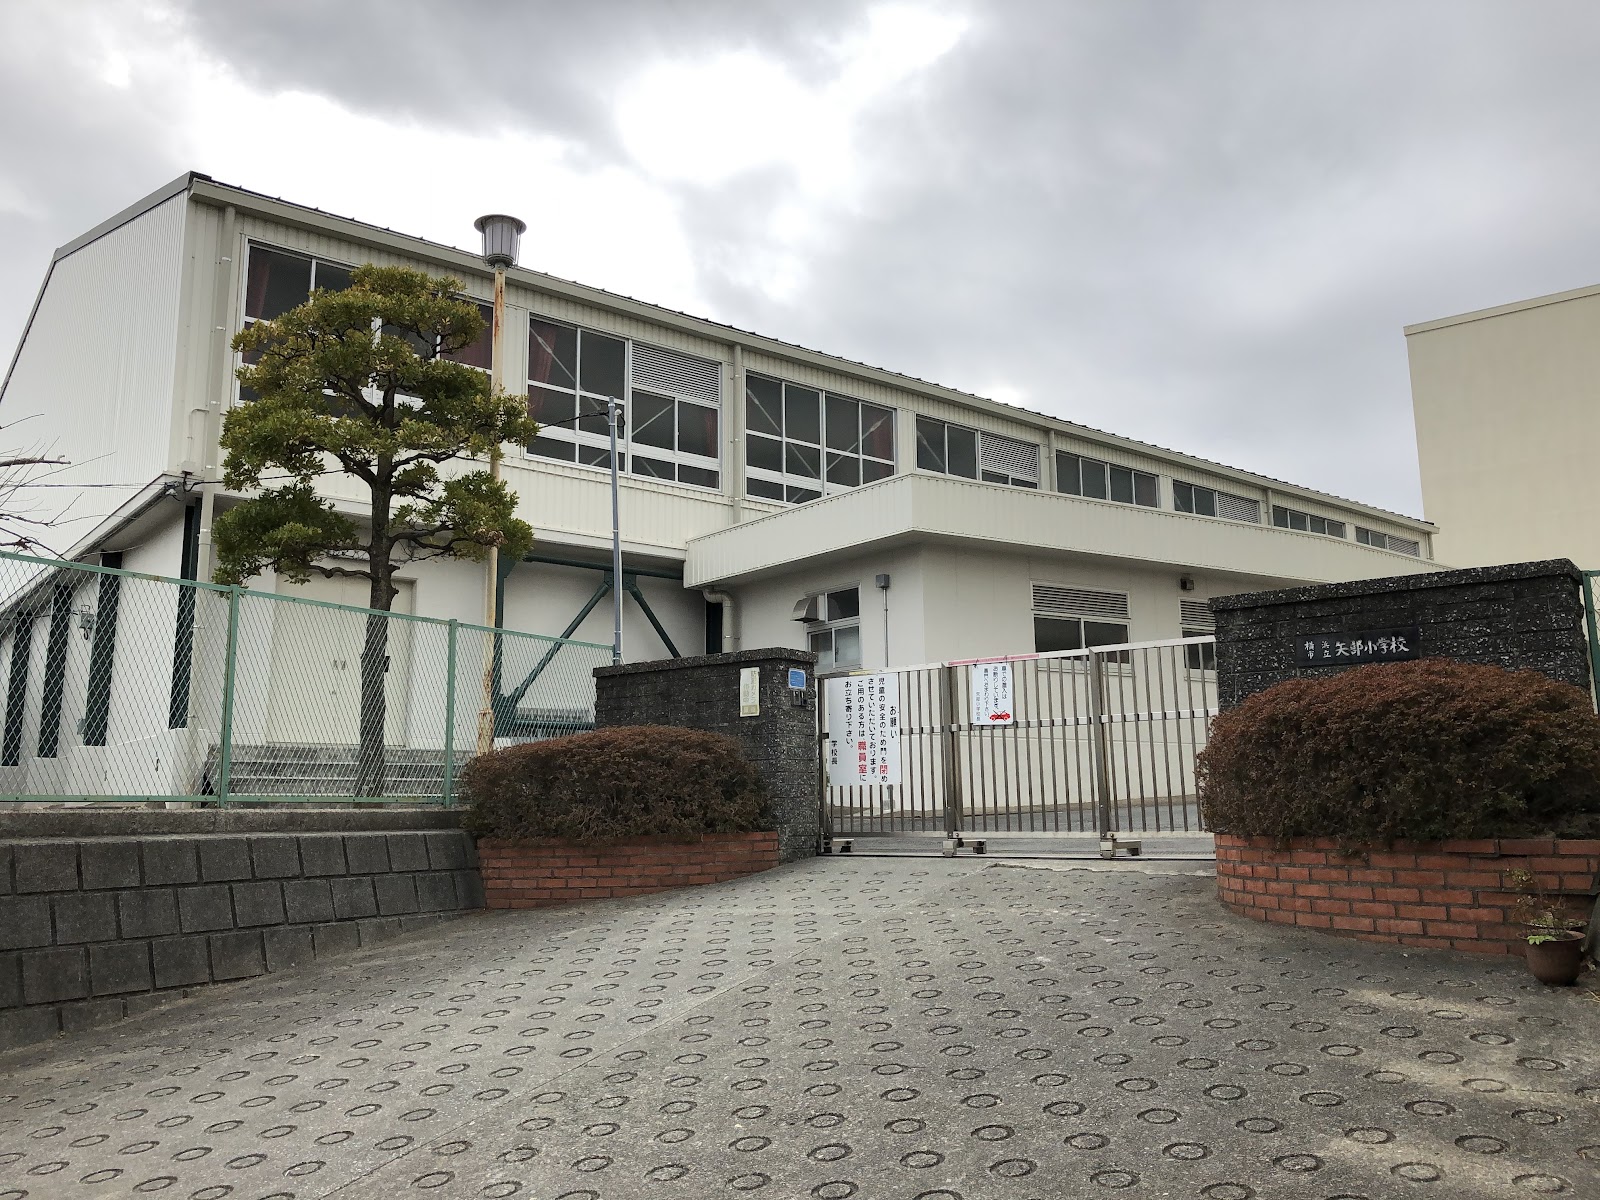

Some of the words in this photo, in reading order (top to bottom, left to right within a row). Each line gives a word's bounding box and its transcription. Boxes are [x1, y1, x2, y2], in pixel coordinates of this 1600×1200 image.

[1335, 636, 1410, 657] 矢部小学校
[844, 680, 854, 749] お立ち寄り下さい。
[868, 678, 877, 779] させていただいております。
[878, 677, 888, 783] 児童の安全のため門を閉め
[889, 705, 898, 739] お願い
[831, 740, 839, 765] 学校長
